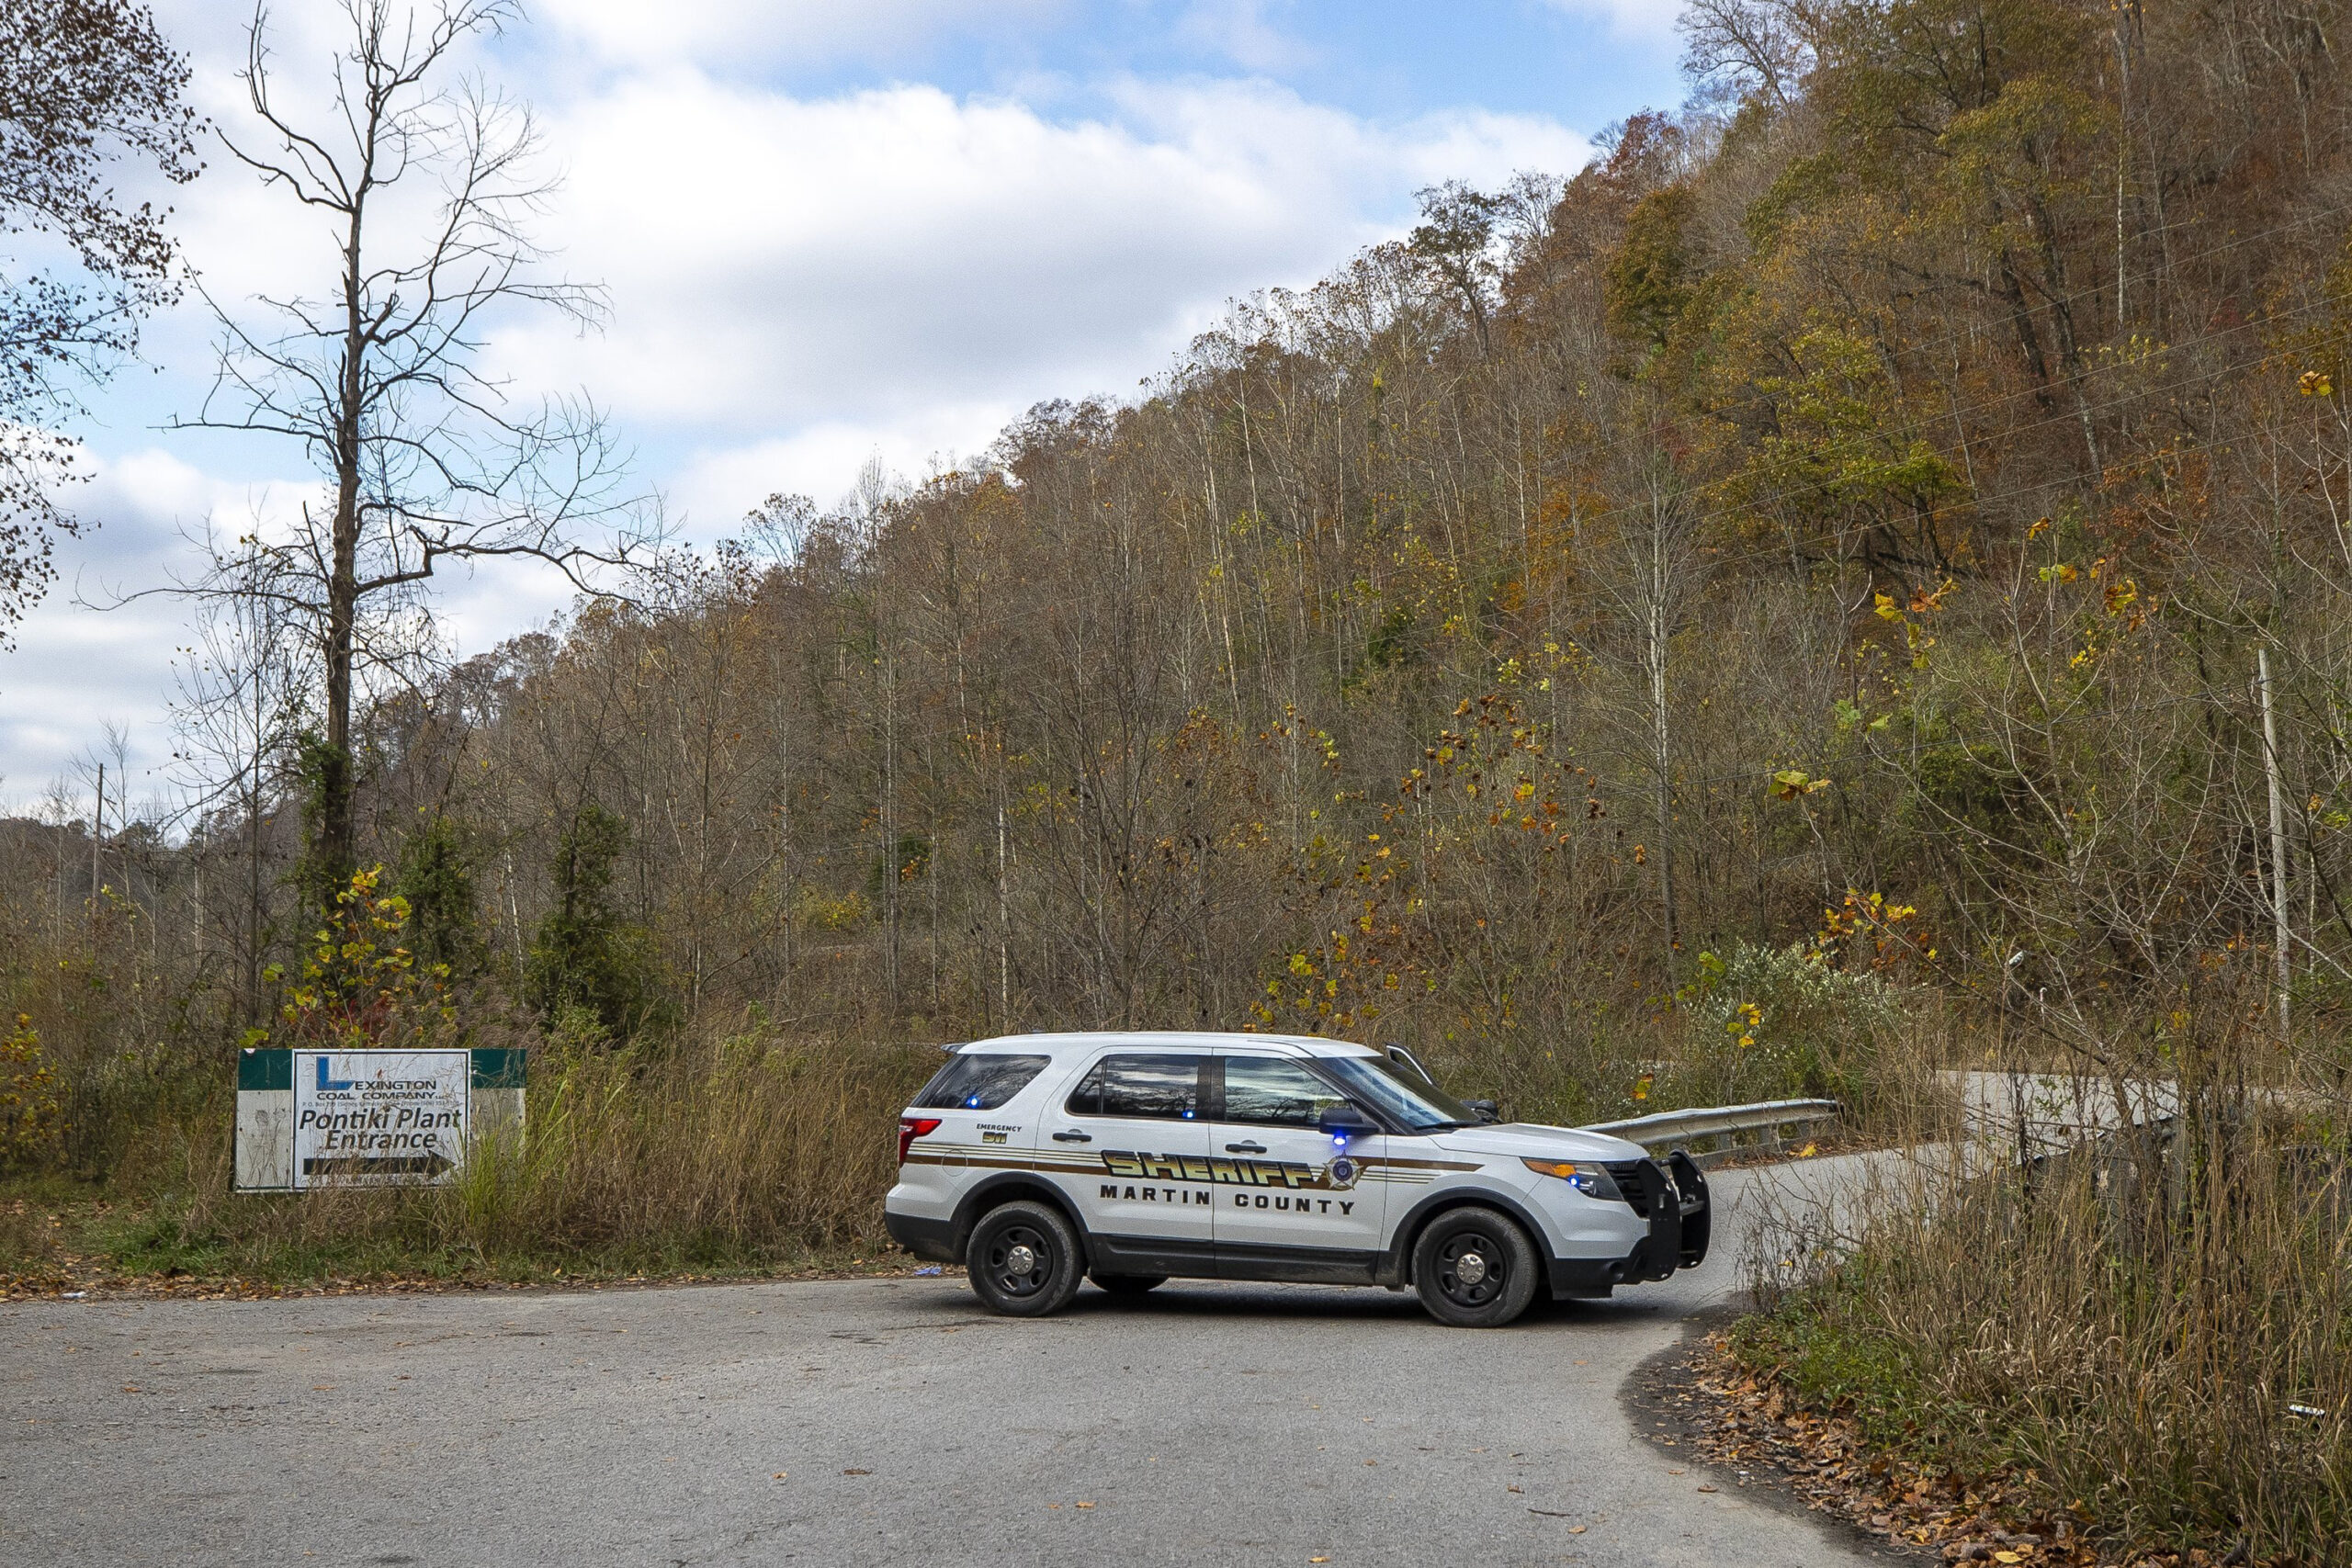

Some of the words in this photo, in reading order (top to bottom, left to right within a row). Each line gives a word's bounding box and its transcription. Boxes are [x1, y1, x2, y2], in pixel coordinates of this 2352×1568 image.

[316, 1056, 436, 1090] LEXINGTON
[317, 1092, 355, 1100] COAL
[300, 1109, 390, 1130] Pontiki
[397, 1108, 461, 1129] Plant
[977, 1123, 1022, 1132] EMERGENCY
[325, 1130, 437, 1149] Entrance
[982, 1131, 1008, 1145] 911
[1101, 1149, 1315, 1190] SHERIFF
[1100, 1184, 1210, 1205] MARTIN
[1235, 1193, 1355, 1216] COUNTY
